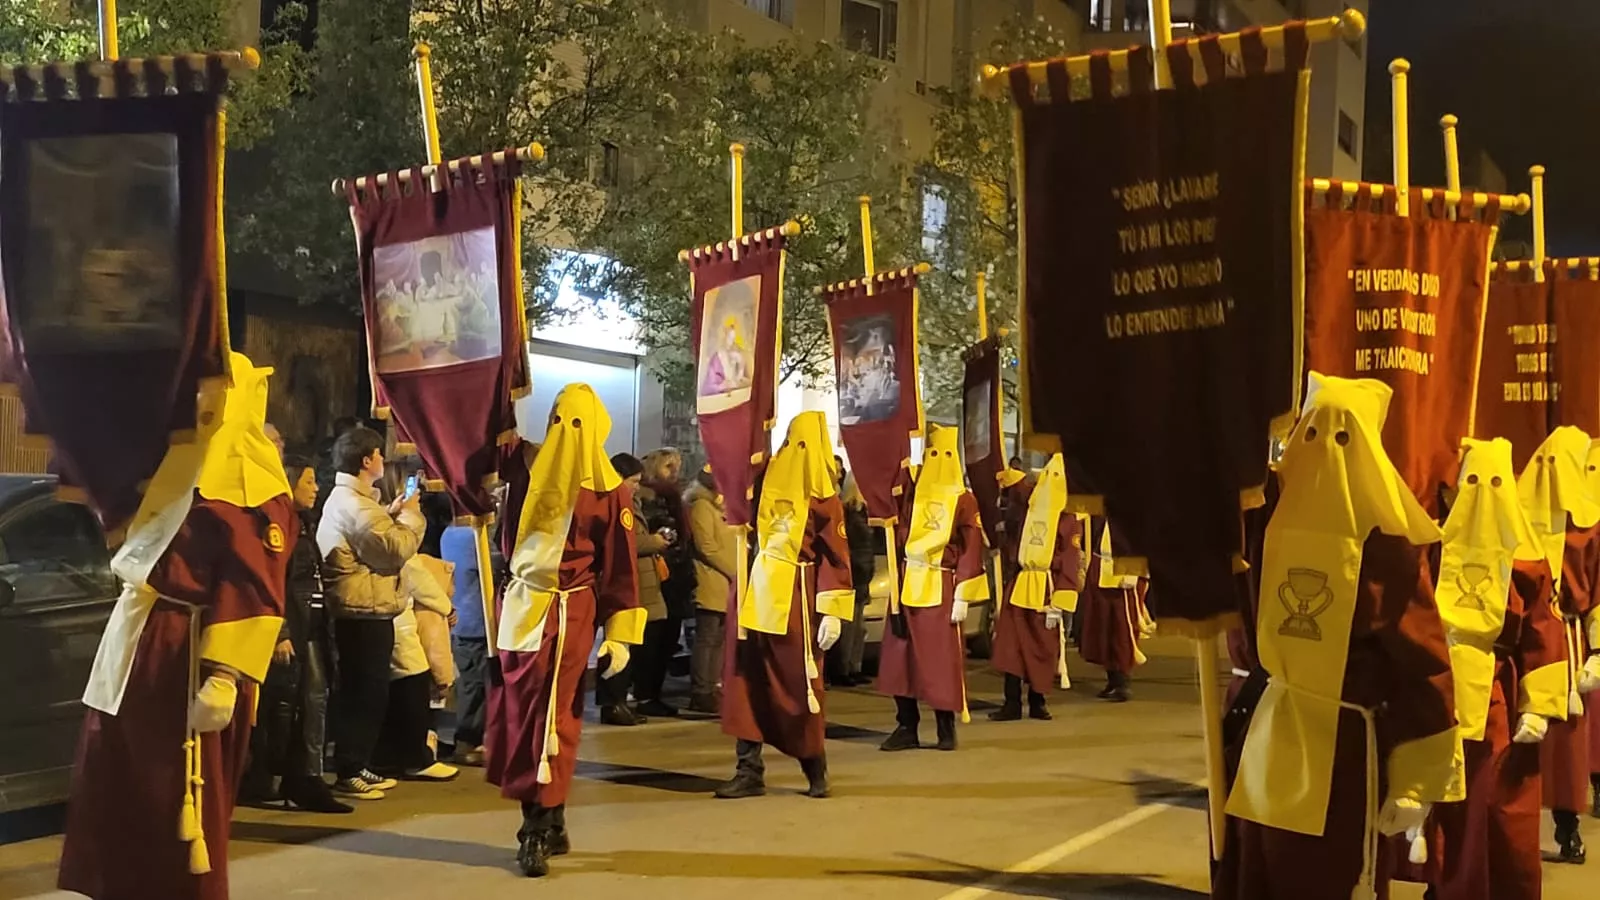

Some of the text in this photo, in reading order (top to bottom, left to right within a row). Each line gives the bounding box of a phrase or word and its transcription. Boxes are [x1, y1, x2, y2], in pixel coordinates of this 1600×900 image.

[1164, 219, 1191, 246] LOS
[1113, 270, 1131, 296] LO
[1134, 267, 1156, 295] QUE
[1158, 262, 1178, 289] YO
[1106, 313, 1122, 338] LO
[1356, 308, 1380, 332] UNO
[1382, 307, 1398, 330] DE
[1355, 348, 1372, 372] ME
